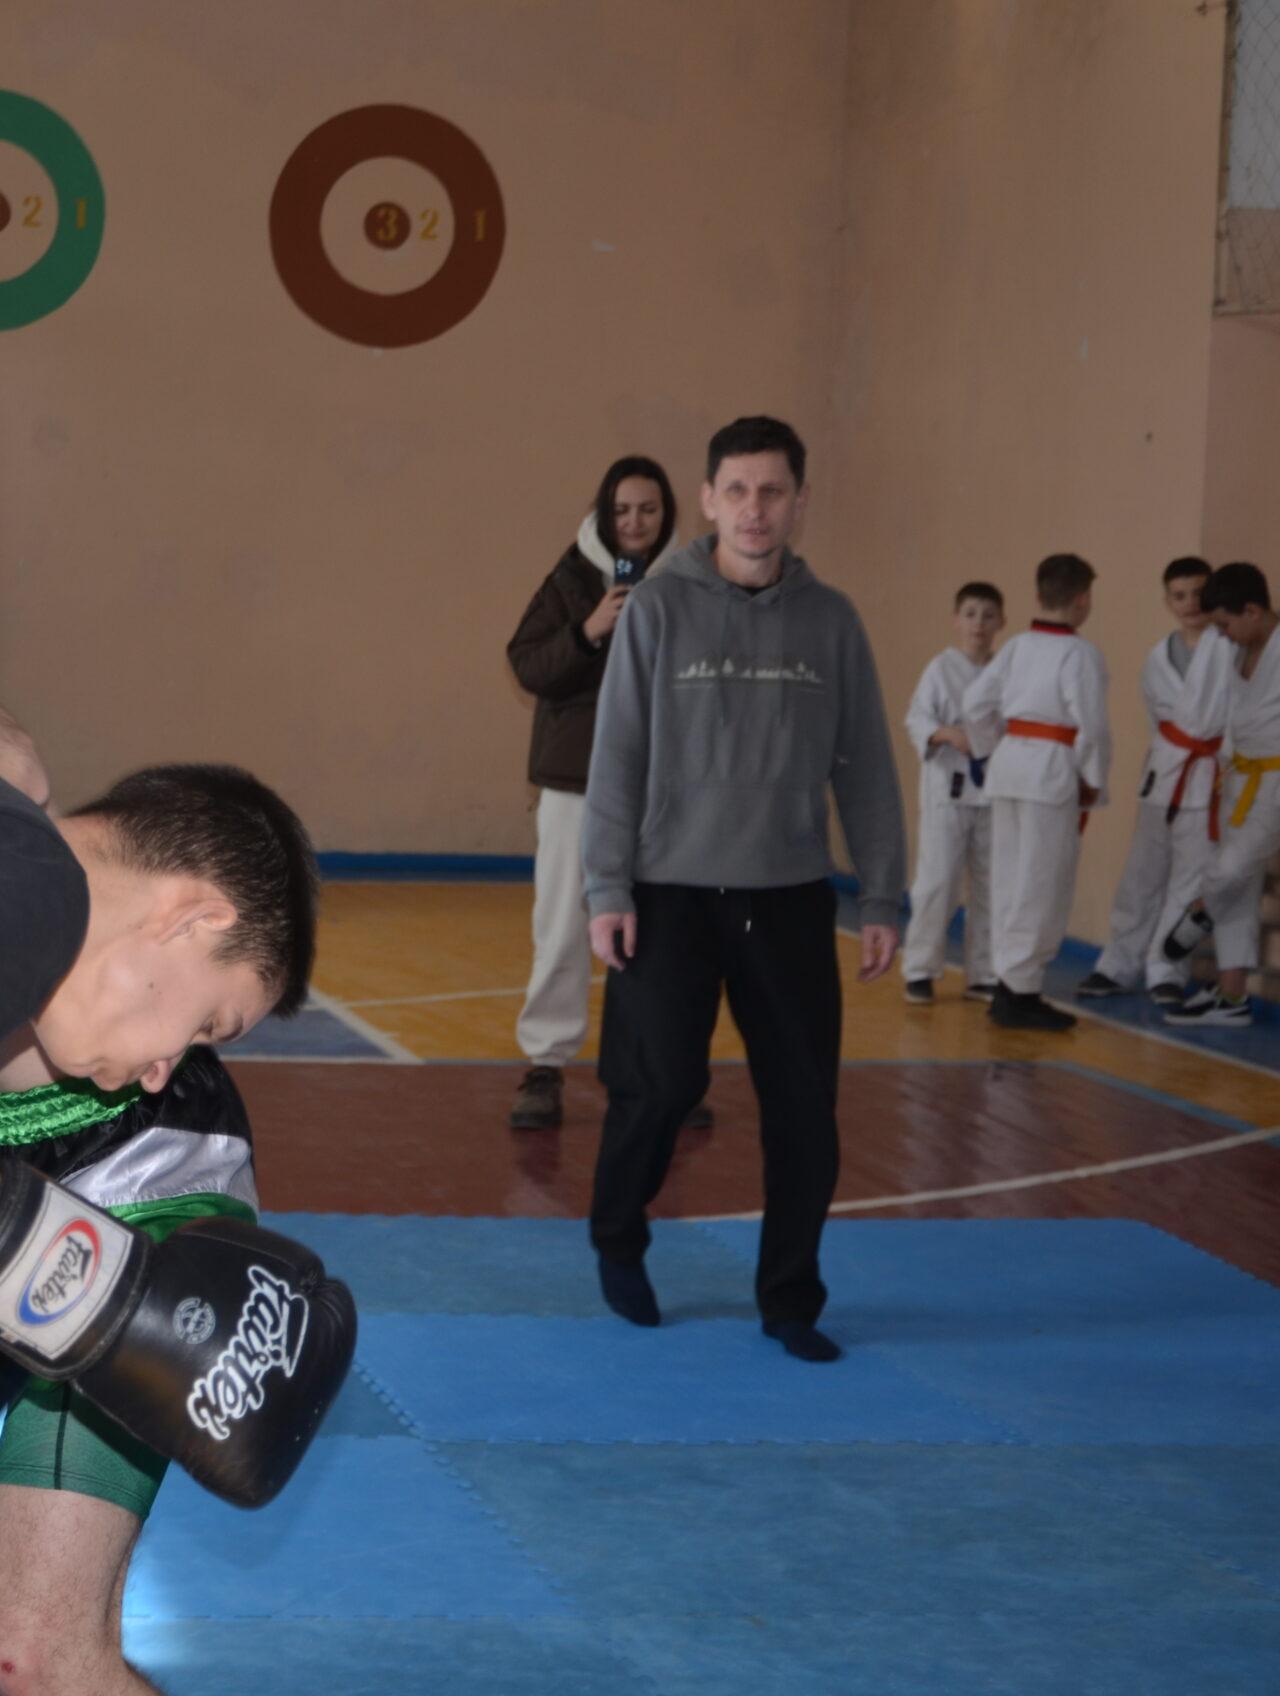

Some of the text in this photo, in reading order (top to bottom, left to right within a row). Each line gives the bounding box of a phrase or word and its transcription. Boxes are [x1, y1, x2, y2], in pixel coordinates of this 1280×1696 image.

[22, 194, 43, 229] 2
[75, 197, 88, 231] 1
[377, 206, 487, 242] 3 2 1
[28, 1234, 94, 1314] Fairtex
[186, 1264, 310, 1441] Fairtex
